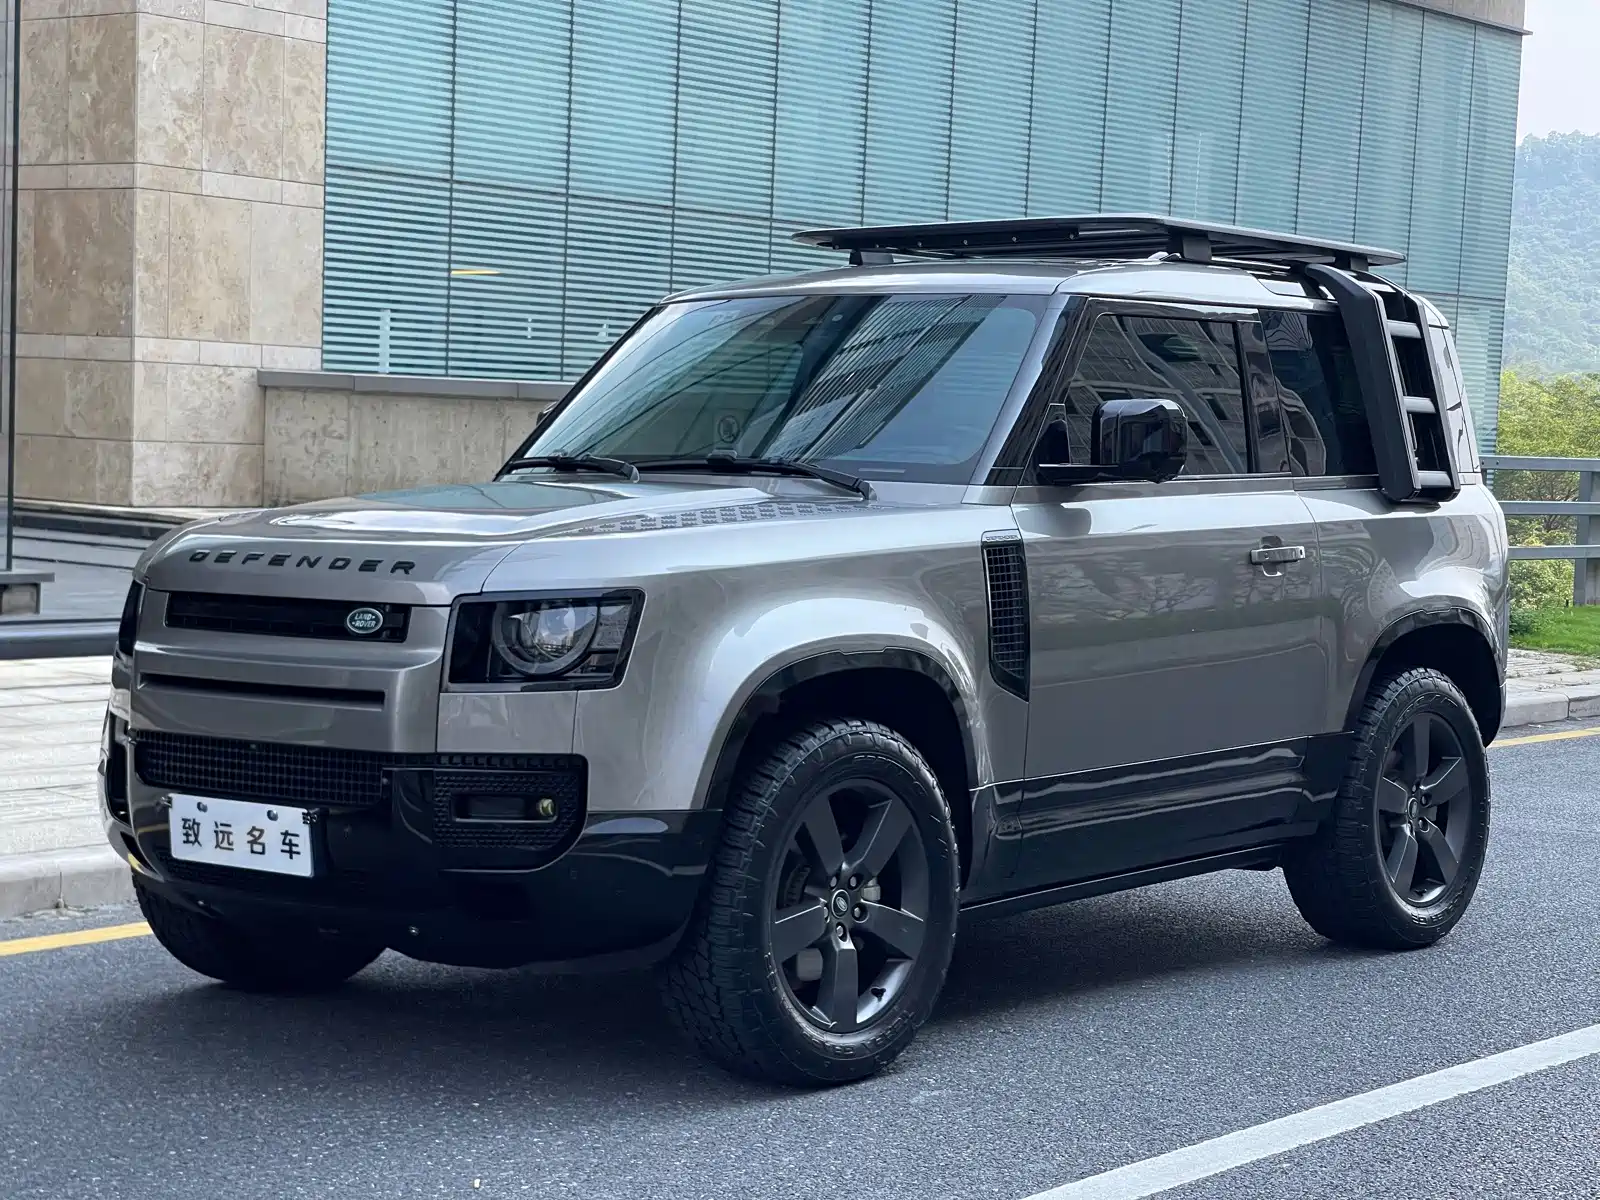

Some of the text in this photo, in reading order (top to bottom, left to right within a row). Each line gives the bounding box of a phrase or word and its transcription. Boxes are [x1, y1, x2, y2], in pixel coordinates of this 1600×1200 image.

[189, 550, 416, 575] DEFENDER
[181, 817, 301, 860] 致远名车
